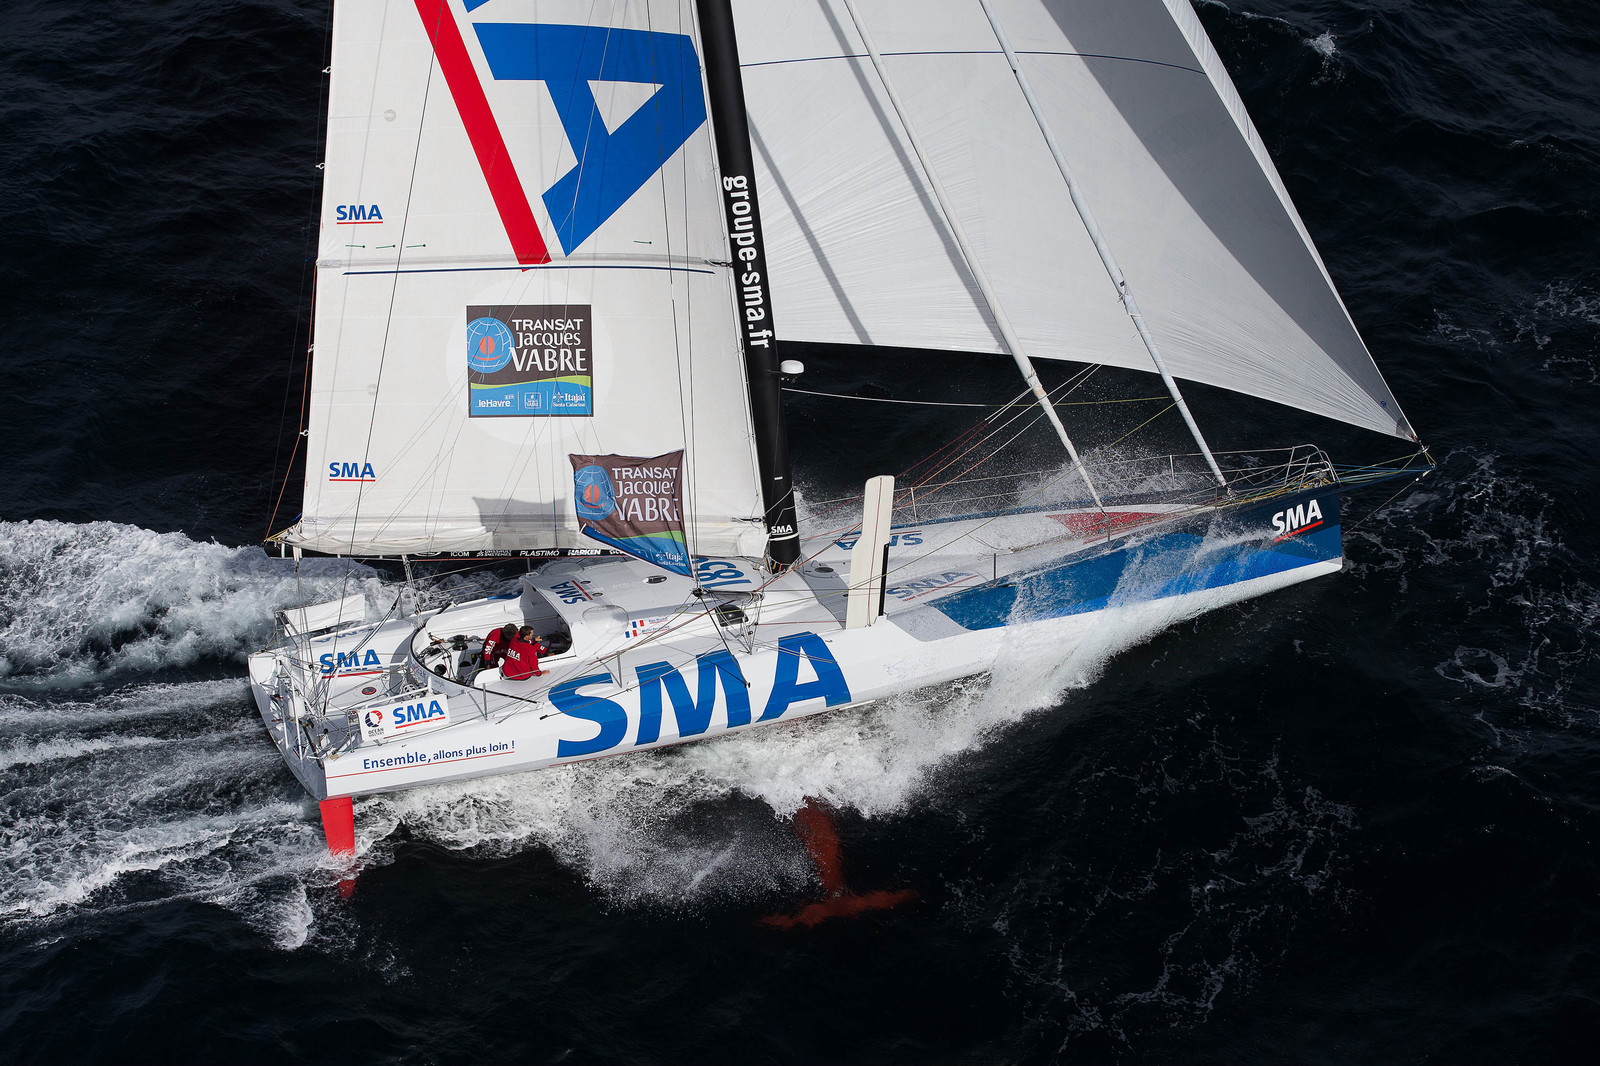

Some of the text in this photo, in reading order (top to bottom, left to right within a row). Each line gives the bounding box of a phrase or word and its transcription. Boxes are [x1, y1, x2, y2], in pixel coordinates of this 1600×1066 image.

[463, 0, 707, 257] A
[336, 205, 383, 221] SMA
[723, 175, 773, 348] groupe-sma.fr
[512, 318, 584, 331] TRANSAT
[516, 331, 581, 349] Jacques
[509, 347, 588, 372] VABRE
[329, 462, 376, 478] SMA
[612, 467, 678, 480] TRANSAT
[771, 524, 793, 534] SMA
[1272, 499, 1323, 535] SMA
[550, 581, 587, 605] SMA
[886, 571, 974, 599] SMA
[485, 640, 496, 655] SMA
[320, 649, 381, 673] SMA
[548, 631, 851, 758] SMA
[393, 700, 445, 725] SMA
[363, 752, 431, 770] Ensemble,
[433, 750, 463, 760] allons
[465, 746, 487, 758] plus
[489, 742, 509, 752] loin
